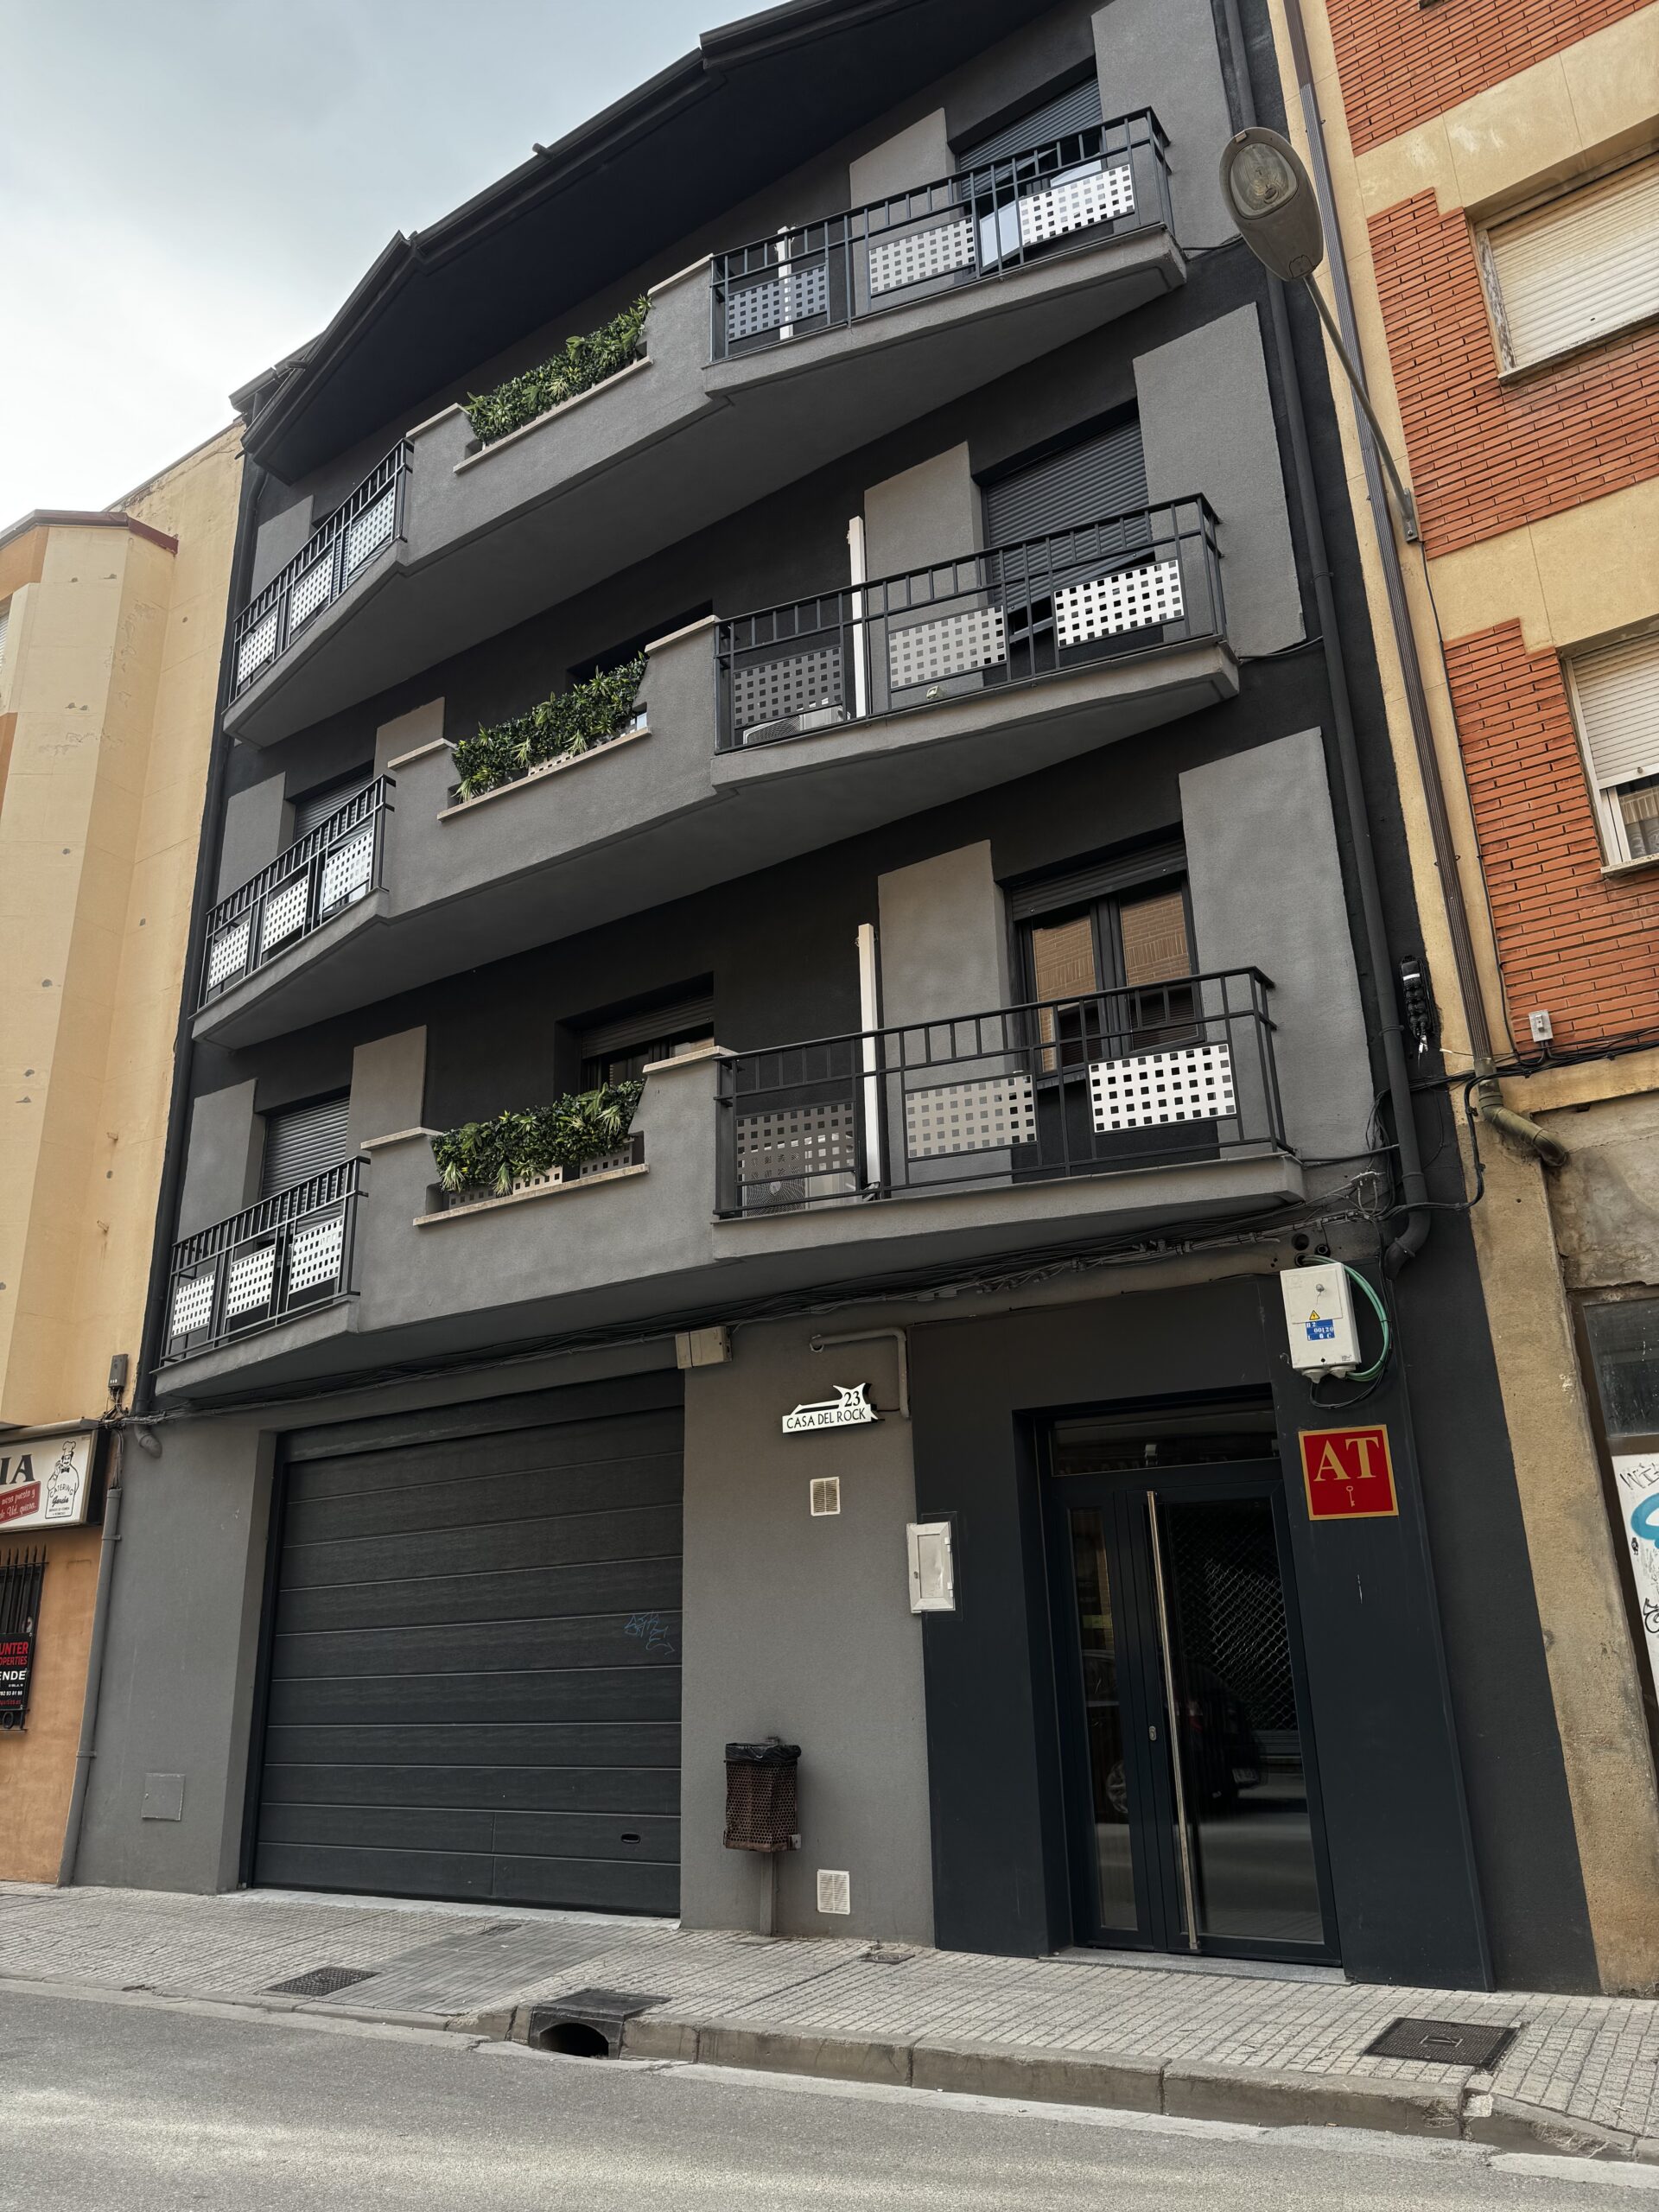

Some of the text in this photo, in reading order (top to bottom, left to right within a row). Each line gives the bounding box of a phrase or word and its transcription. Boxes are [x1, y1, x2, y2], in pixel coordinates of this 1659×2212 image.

[844, 1391, 861, 1407] 23
[786, 1408, 866, 1429] CASA DEL ROCK
[1313, 1437, 1380, 1481] AT
[49, 1484, 74, 1498] CATERING
